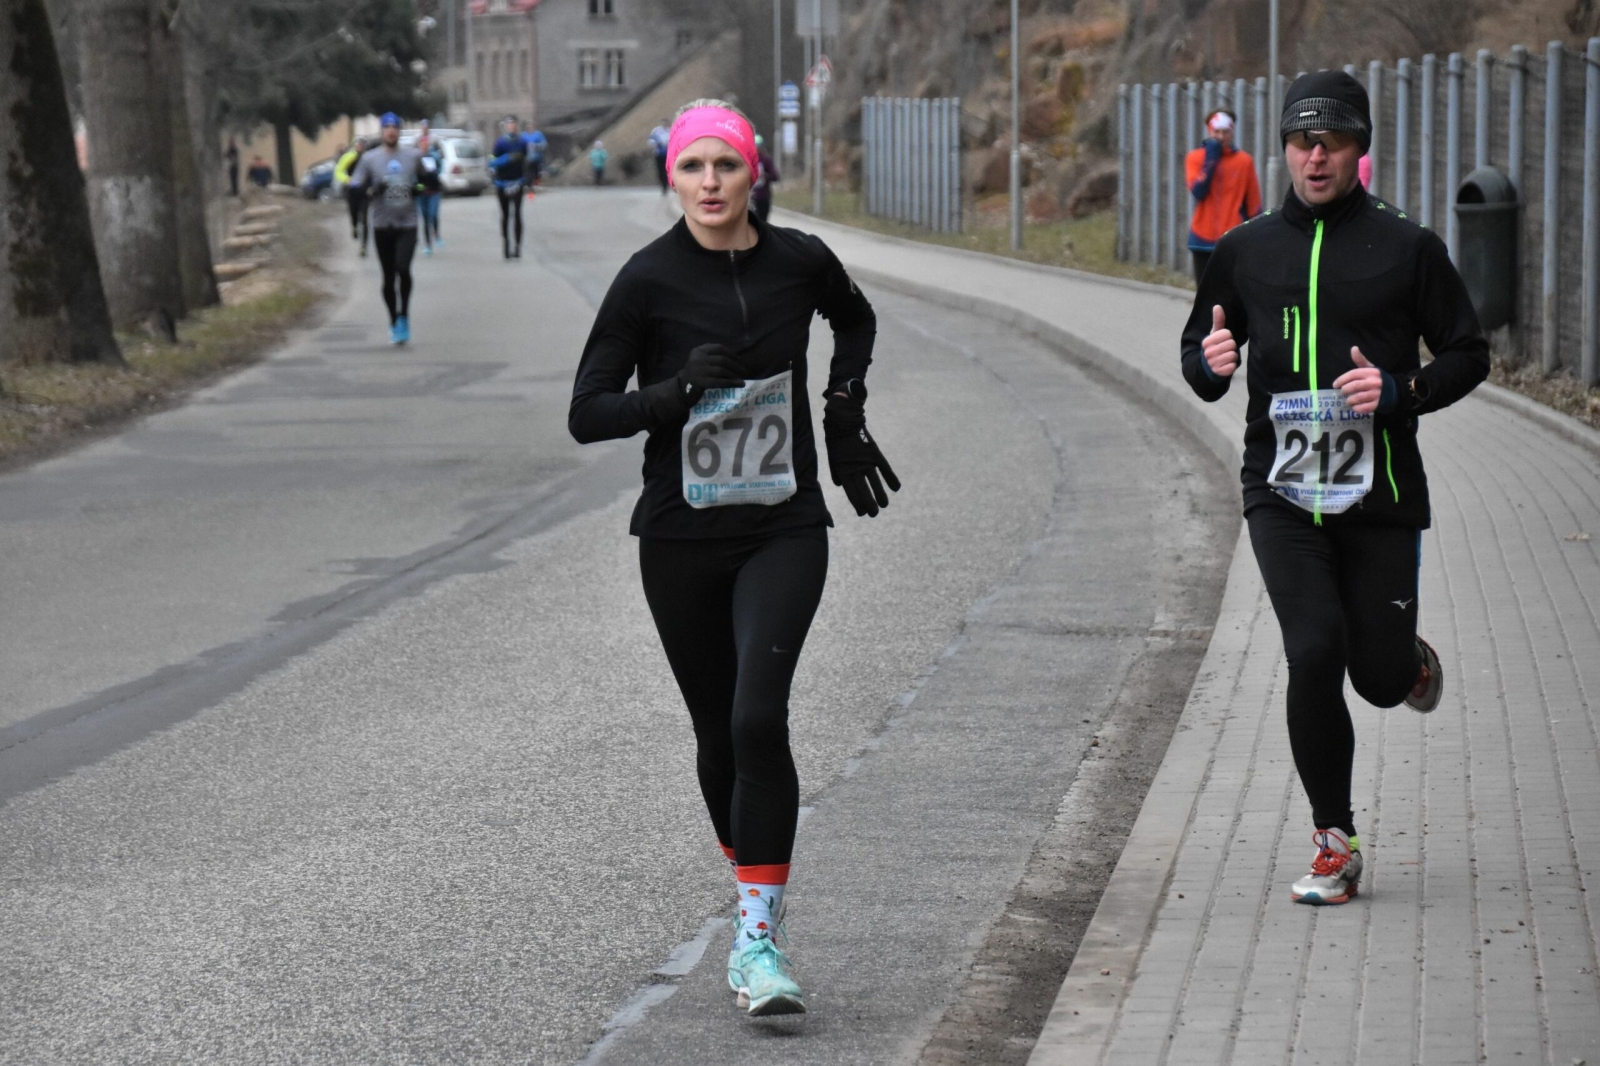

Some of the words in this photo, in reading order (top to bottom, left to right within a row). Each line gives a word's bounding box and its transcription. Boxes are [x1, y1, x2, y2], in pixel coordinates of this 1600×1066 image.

[754, 391, 787, 406] LIGA
[1275, 395, 1314, 411] ZIMNÍ
[1340, 410, 1371, 421] LIGA
[687, 413, 789, 478] 672
[1274, 429, 1364, 485] 212
